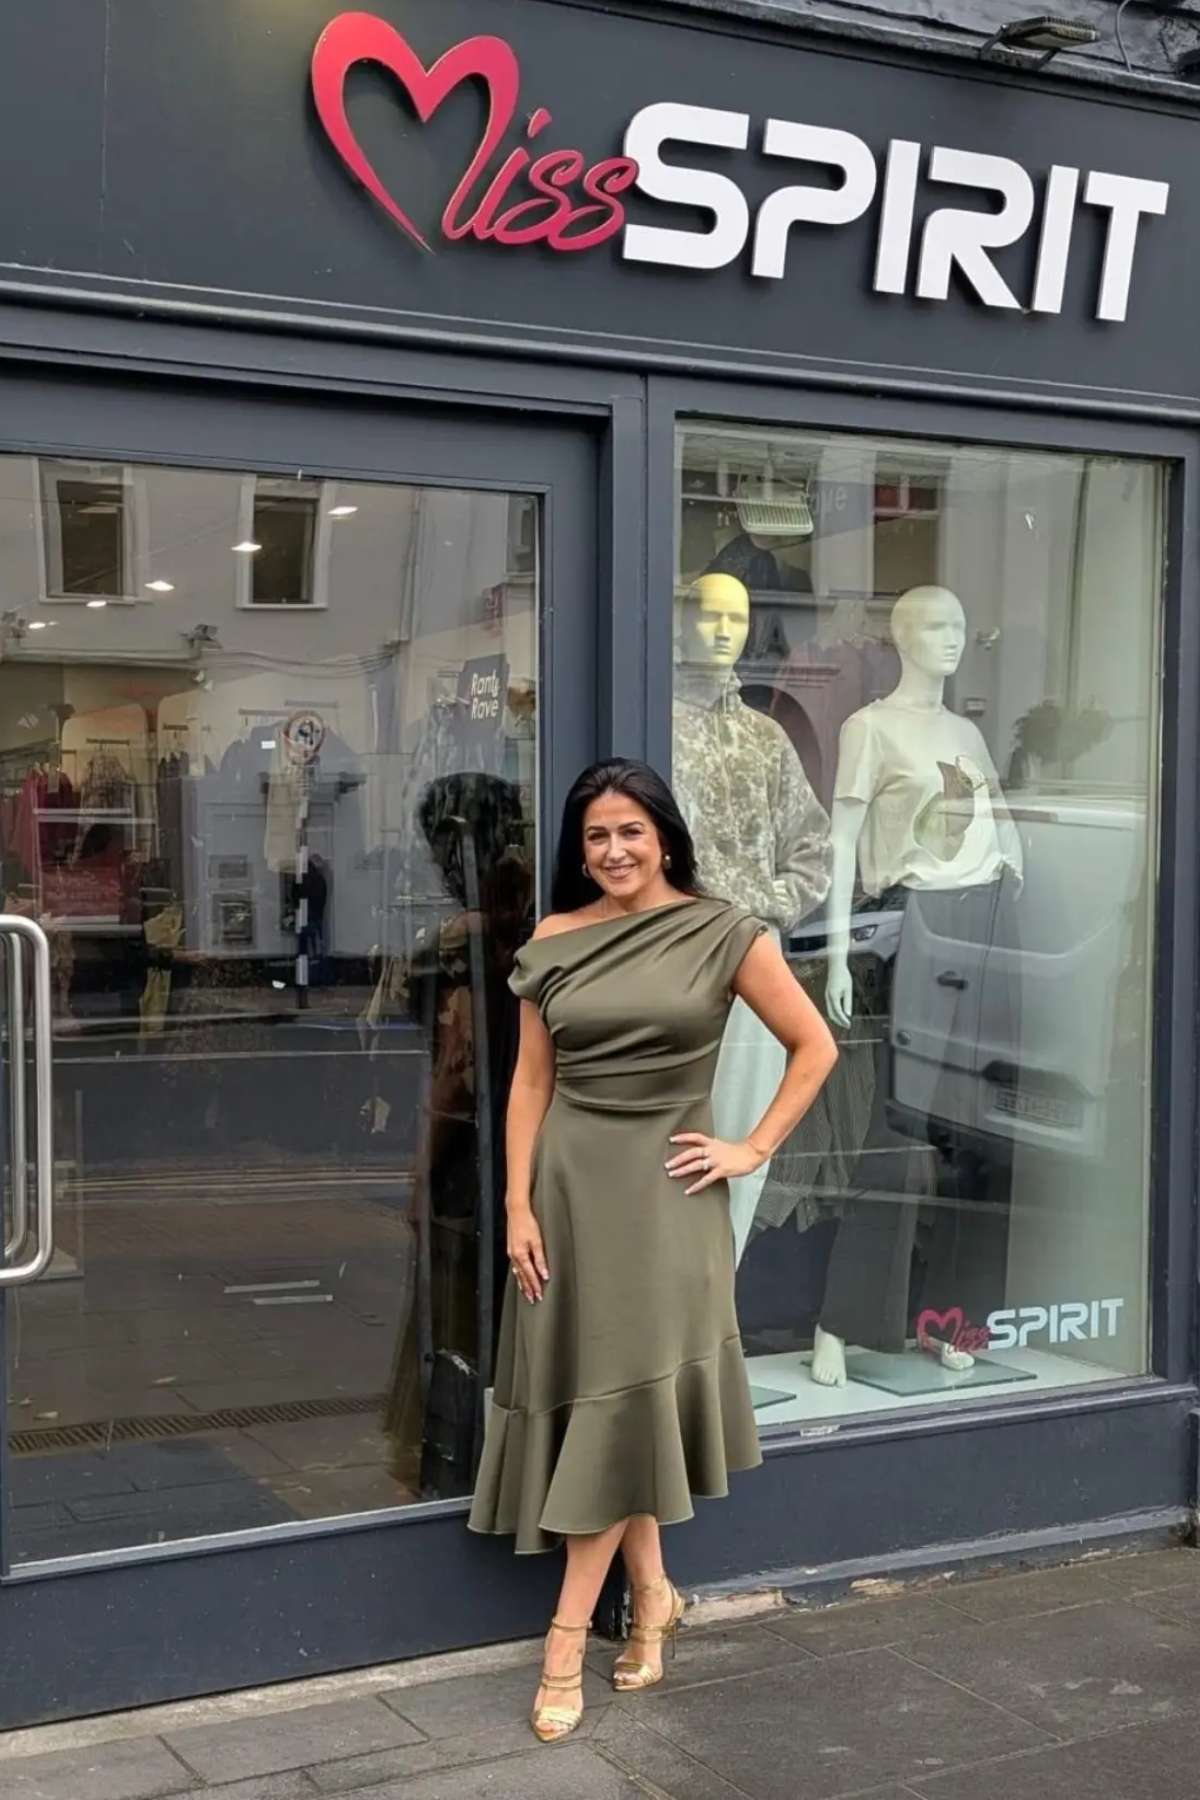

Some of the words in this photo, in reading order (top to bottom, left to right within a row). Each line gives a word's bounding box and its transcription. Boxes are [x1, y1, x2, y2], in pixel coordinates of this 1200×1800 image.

[312, 11, 639, 255] Miss
[623, 101, 1170, 322] SPIRIT
[472, 697, 499, 720] Rave
[986, 1298, 1124, 1350] SPIRIT
